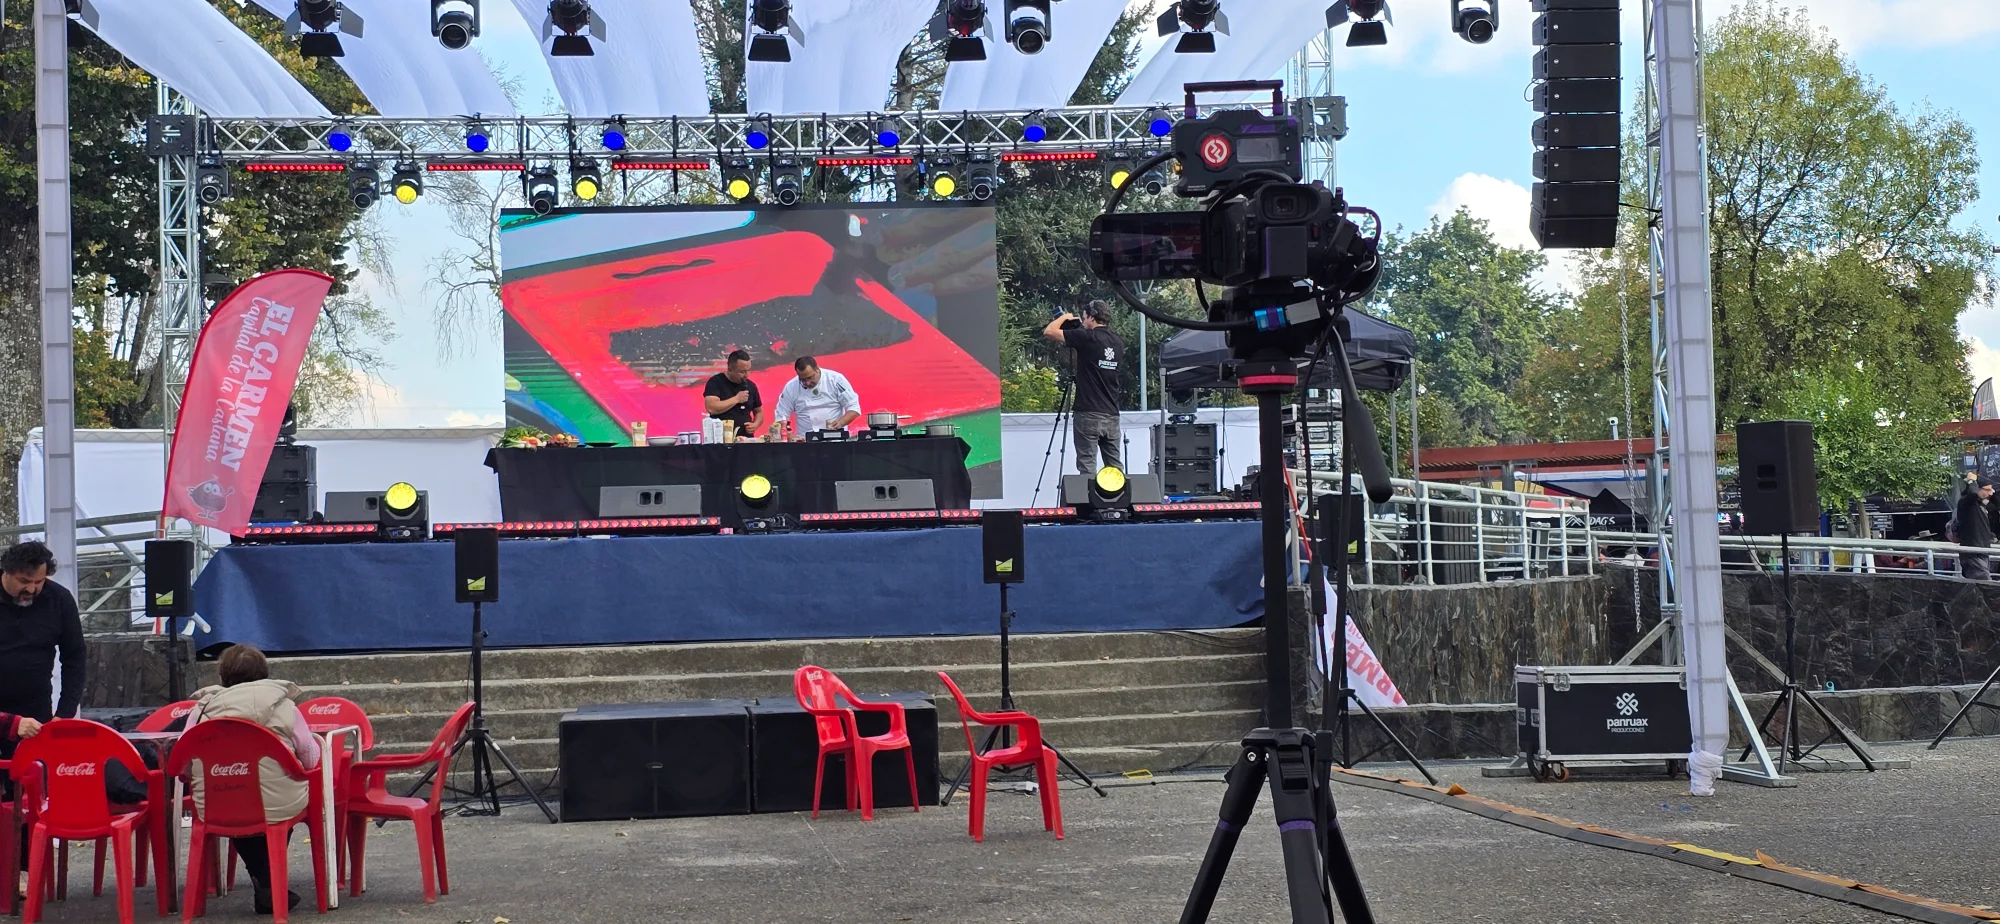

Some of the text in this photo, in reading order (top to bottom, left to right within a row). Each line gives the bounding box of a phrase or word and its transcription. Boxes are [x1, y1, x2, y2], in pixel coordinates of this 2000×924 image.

[205, 296, 272, 463] Capital de la Castaña
[221, 301, 295, 472] EL CARMEN
[1606, 718, 1649, 730] panruax
